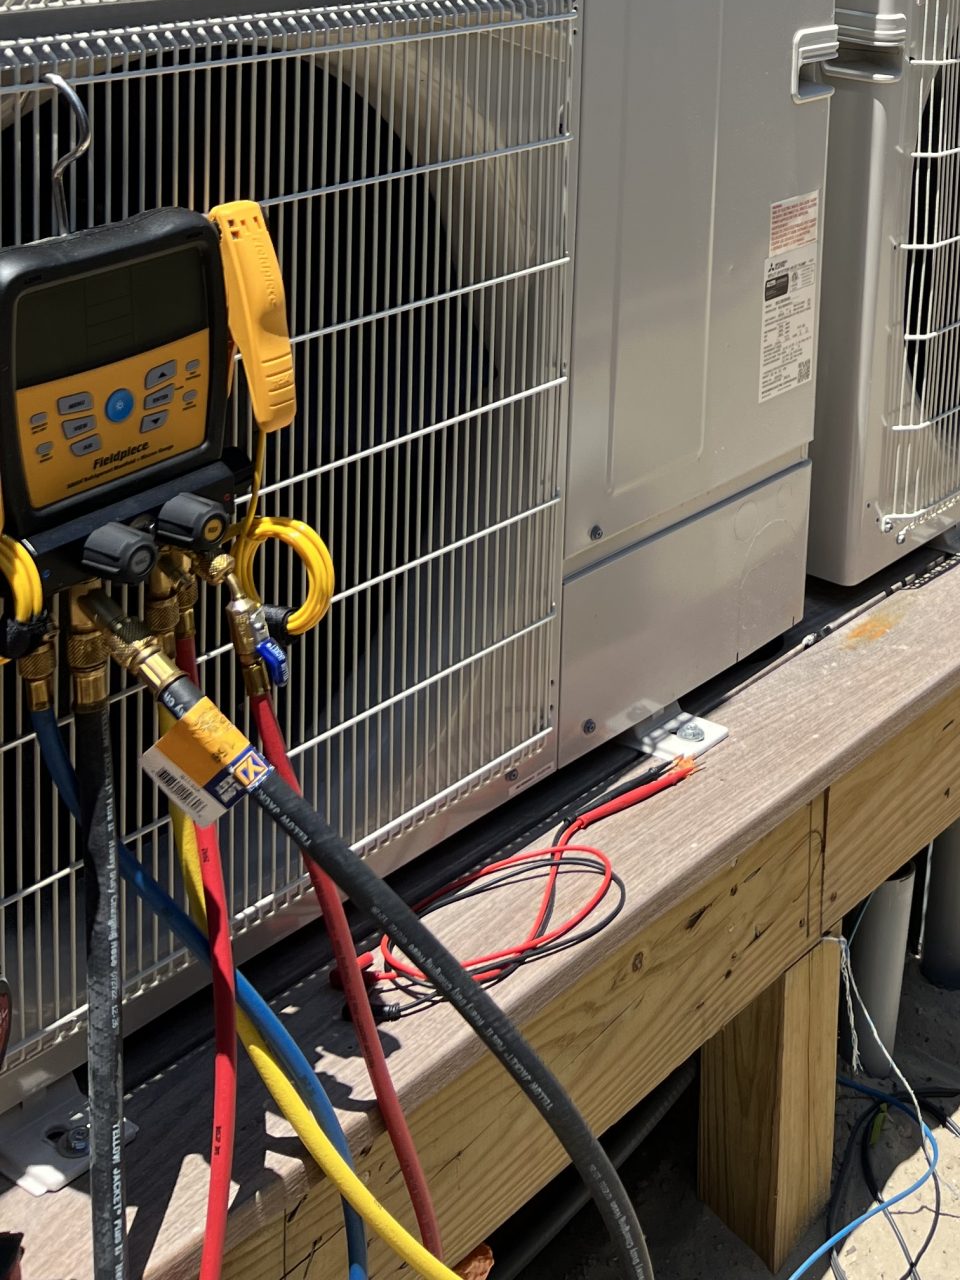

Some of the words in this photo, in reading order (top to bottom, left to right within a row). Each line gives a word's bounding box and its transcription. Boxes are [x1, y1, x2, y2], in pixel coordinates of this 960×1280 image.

[93, 441, 150, 470] Fieldpiece
[258, 788, 280, 813] JACK
[281, 814, 312, 848] YELLOW
[107, 894, 118, 940] Charging
[110, 940, 118, 967] Hose
[528, 1081, 554, 1112] YELLOW
[112, 1123, 121, 1165] YELLOW
[113, 1219, 122, 1245] Plus
